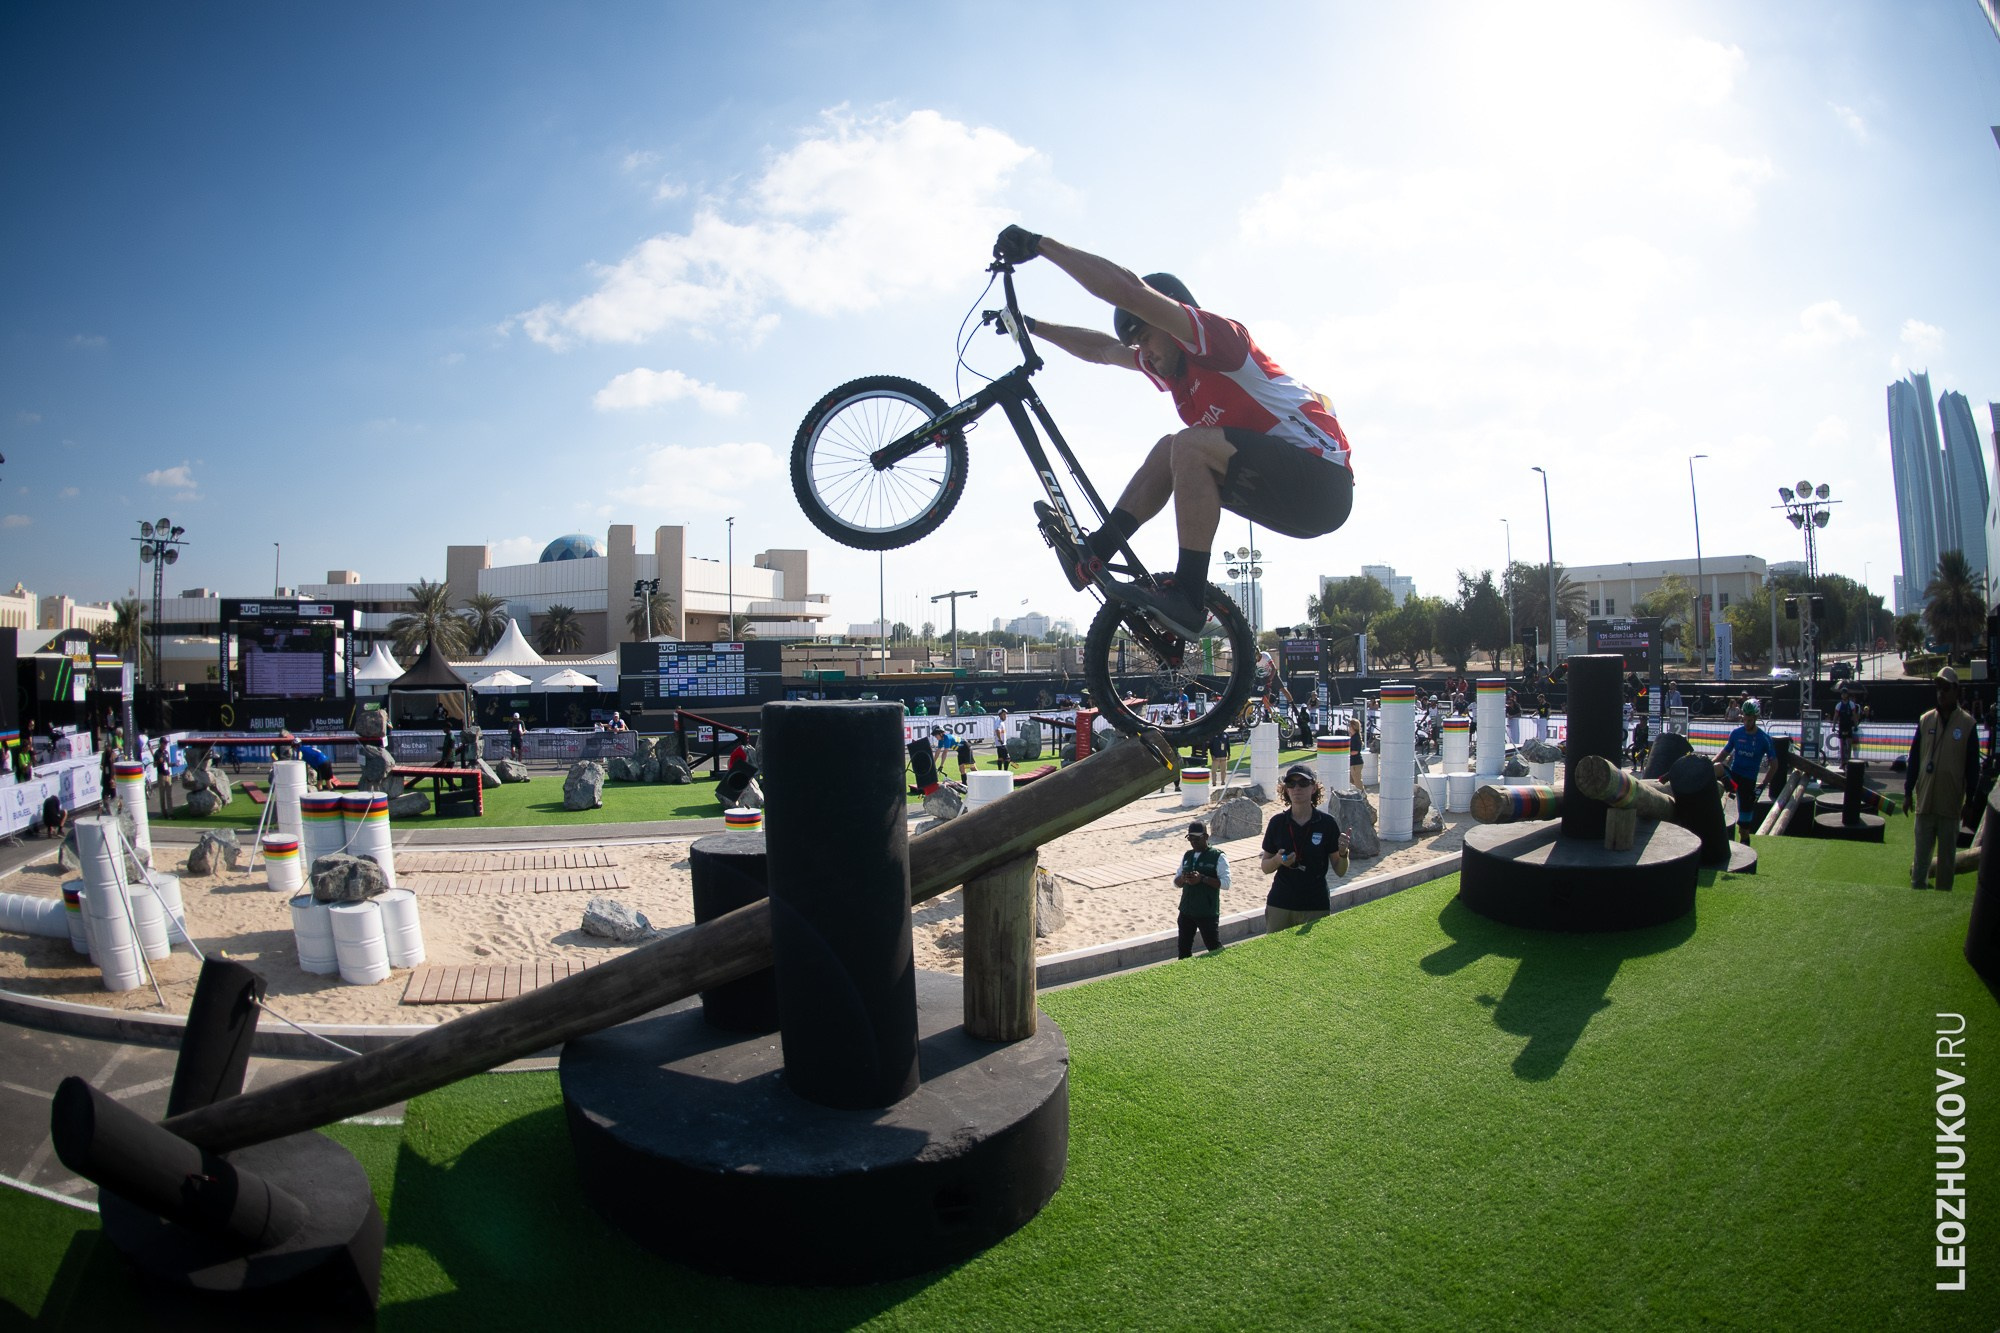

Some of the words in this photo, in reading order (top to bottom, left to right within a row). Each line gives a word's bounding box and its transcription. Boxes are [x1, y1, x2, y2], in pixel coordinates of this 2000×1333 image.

[1039, 470, 1085, 546] CLEAN
[244, 605, 259, 614] UCI
[346, 632, 354, 689] #Abudhabi2024
[250, 718, 265, 729] ABU
[266, 717, 285, 729] DHABI
[913, 721, 978, 738] TISOT
[1674, 724, 1681, 735] 2
[1806, 727, 1815, 742] 3
